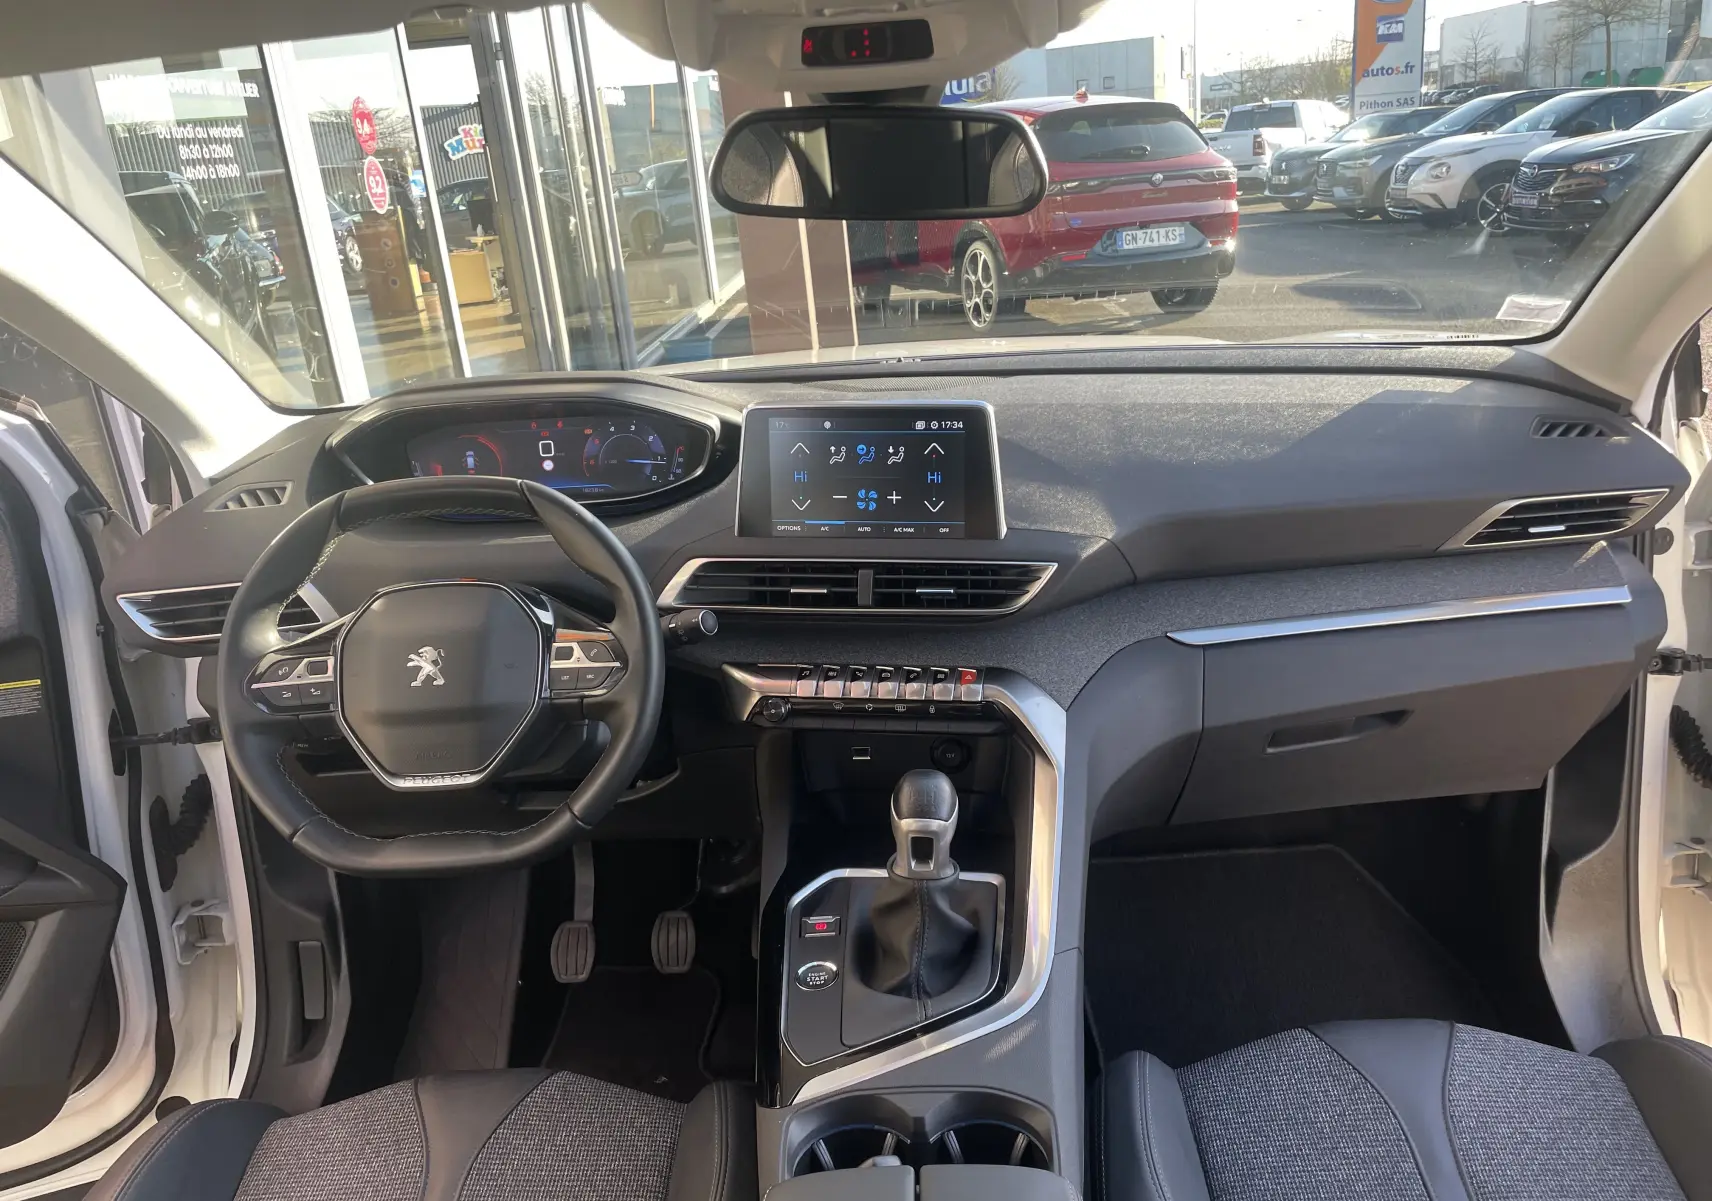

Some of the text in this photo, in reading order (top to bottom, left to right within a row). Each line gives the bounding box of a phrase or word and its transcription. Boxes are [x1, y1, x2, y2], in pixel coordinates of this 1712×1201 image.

[1362, 62, 1415, 78] autos.fr
[1360, 96, 1416, 110] Pithon SAS
[157, 123, 244, 139] Du lundi au vendredi
[179, 143, 234, 160] 8h30 à 12h00
[181, 163, 240, 181] 14h00 à 18h00
[1124, 228, 1179, 246] GN-741-KS
[941, 421, 964, 429] 17:34
[794, 471, 808, 483] Hi
[927, 471, 941, 484] Hi
[403, 773, 471, 785] PEUGEOT
